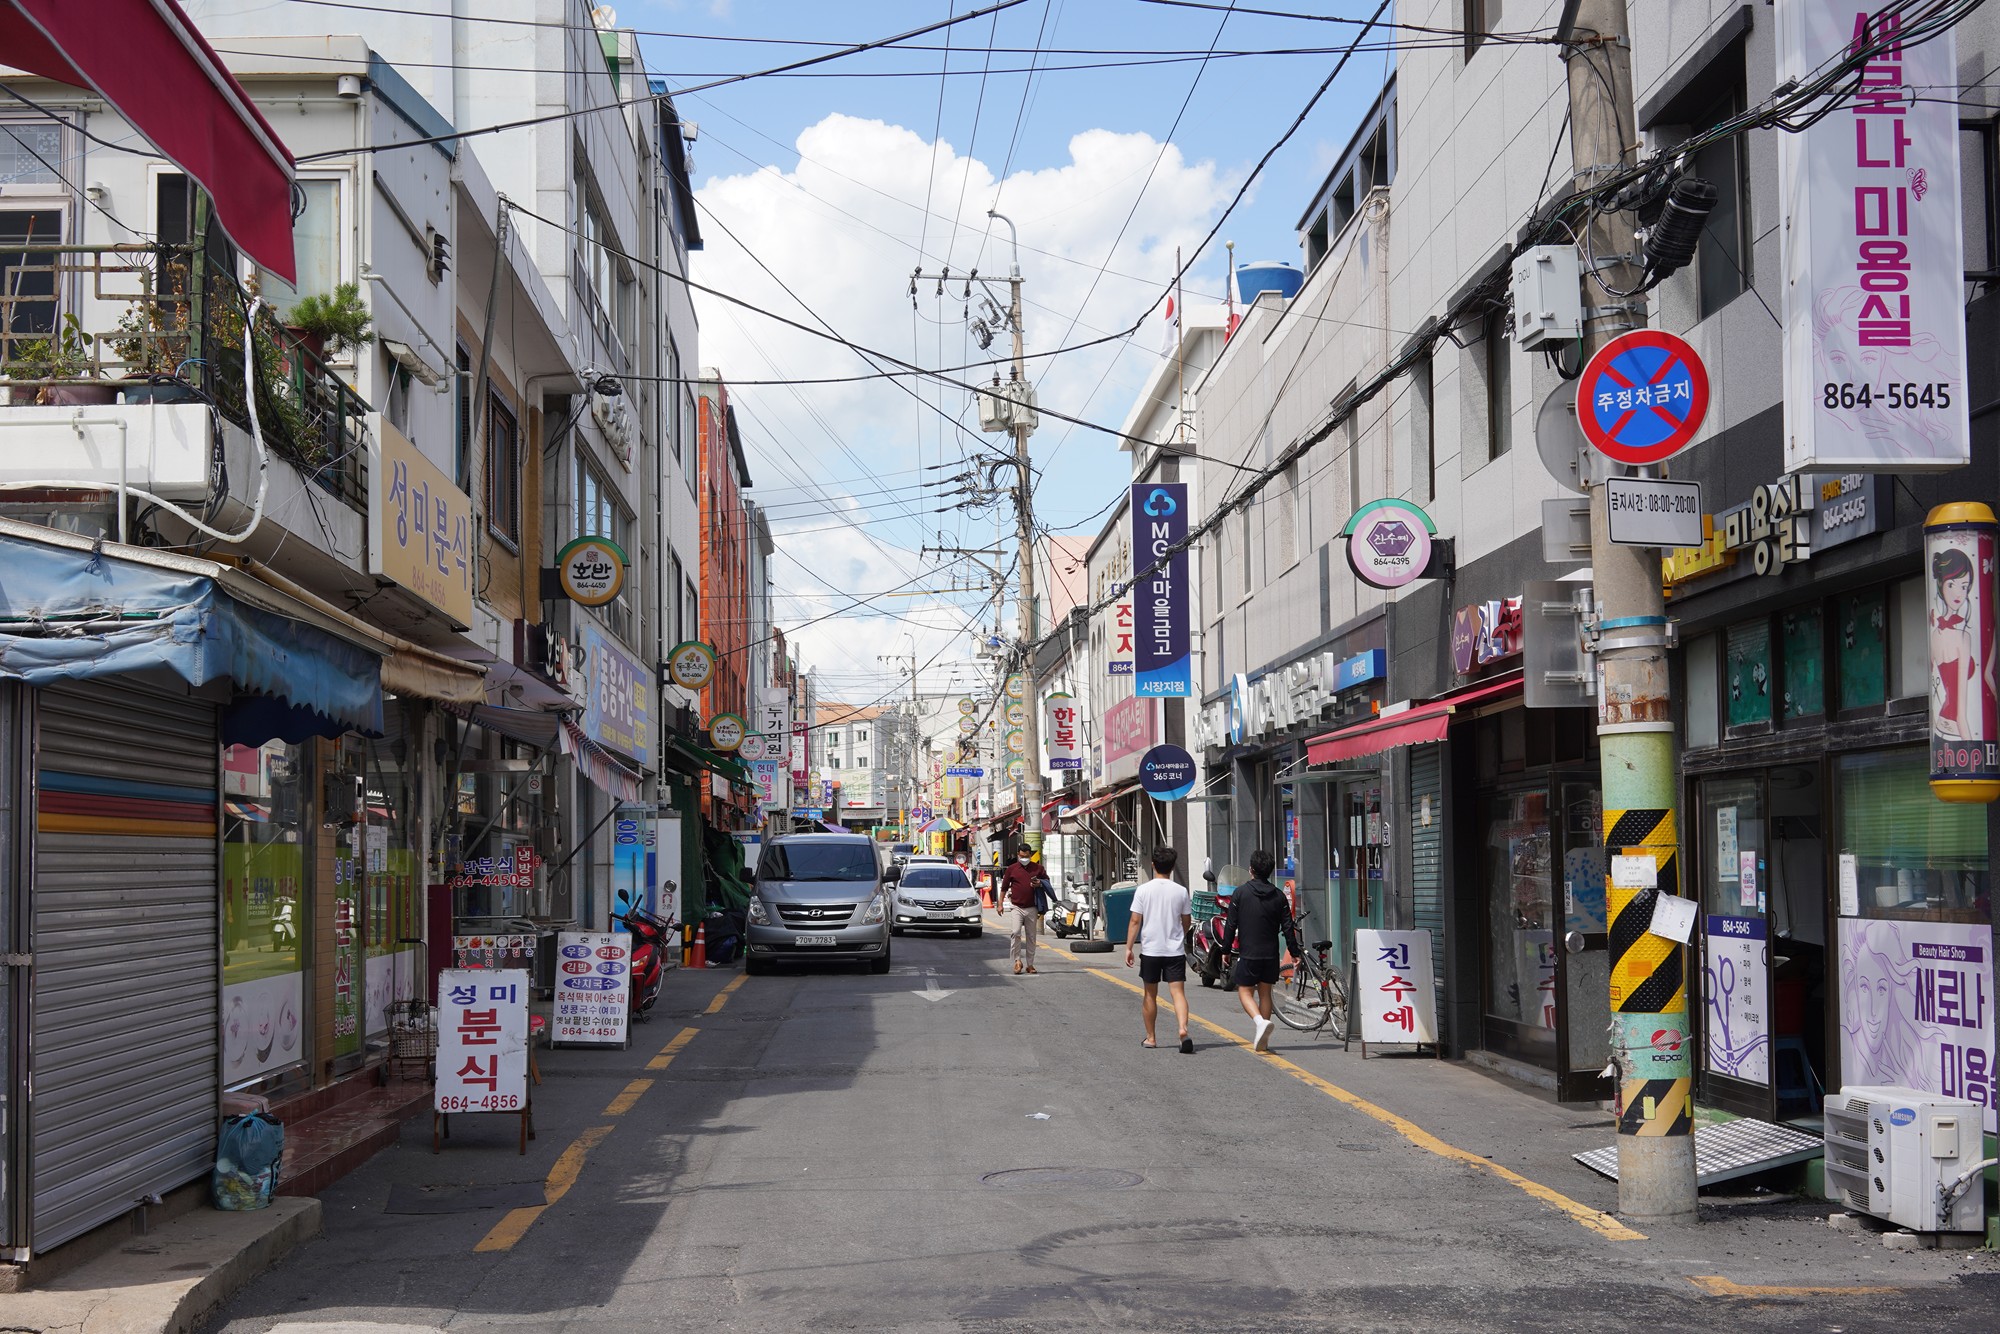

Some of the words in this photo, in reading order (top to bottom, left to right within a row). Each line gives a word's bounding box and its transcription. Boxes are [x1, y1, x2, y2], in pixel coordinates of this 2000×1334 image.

[1854, 186, 1912, 347] 미용실
[1597, 379, 1690, 412] 주정차금지
[1823, 383, 1951, 410] 864-5645
[1821, 479, 1841, 501] HAIR
[1649, 494, 1696, 514] 08:00~20:00
[1822, 496, 1866, 531] 864-5645
[389, 459, 467, 592] 성미분식
[1725, 473, 1804, 576] 미용실
[1373, 532, 1409, 546] 진수예
[572, 562, 612, 580] 호반
[1373, 557, 1410, 566] 864-4395
[576, 581, 607, 589] 864-4450
[1142, 681, 1185, 693] 시장지점
[766, 707, 783, 755] 누가의원
[1052, 707, 1077, 751] 한복
[757, 763, 775, 773] 현대
[1052, 761, 1079, 769] 863-1342
[1937, 743, 1982, 773] shop
[1153, 772, 1168, 781] 365
[1168, 772, 1183, 780] 코너
[518, 850, 532, 887] 냉방중
[1722, 919, 1750, 935] 864-5645
[566, 946, 587, 957] 우동
[600, 947, 621, 958] 라면
[1918, 944, 1938, 958] Beauty
[1938, 945, 1951, 958] Hair
[1950, 946, 1967, 960] Shop
[566, 962, 588, 973] 김밥
[570, 978, 614, 989] 잔치국수
[1376, 943, 1417, 1033] 진수예
[447, 984, 517, 1005] 성미
[1914, 967, 1985, 1030] 새로나
[561, 1027, 617, 1037] 864-4450
[456, 1008, 502, 1092] 분식
[440, 1094, 518, 1110] 864-4856
